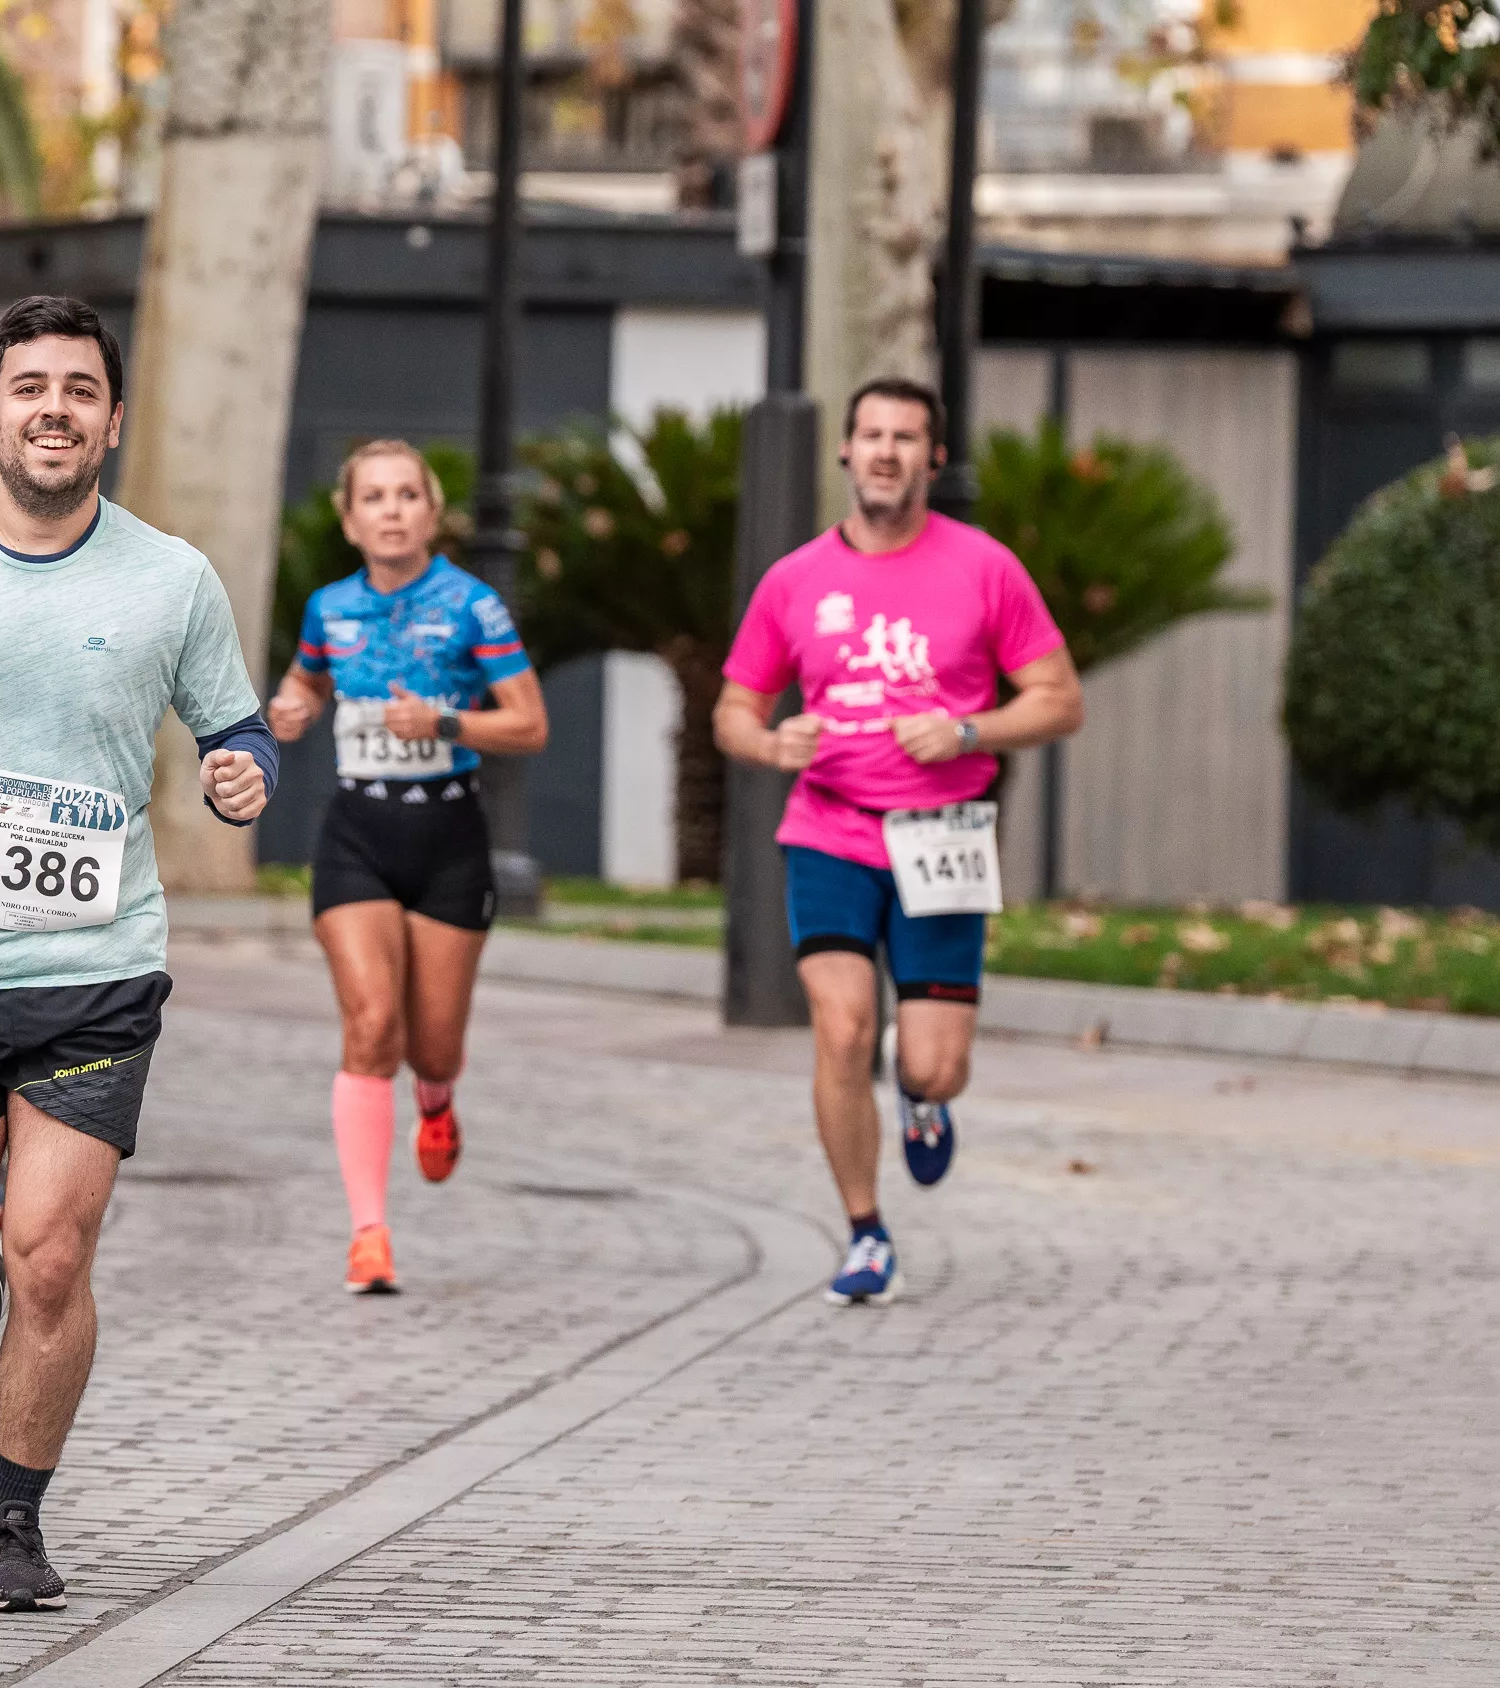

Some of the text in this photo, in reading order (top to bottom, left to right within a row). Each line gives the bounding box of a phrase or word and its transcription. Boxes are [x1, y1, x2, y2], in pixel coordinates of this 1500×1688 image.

[0, 777, 41, 792] PROVINCIAL
[43, 784, 52, 793] DE
[6, 786, 52, 801] POPULARES
[52, 785, 97, 808] 2024
[10, 833, 68, 848] POR LA IGUALDAD
[12, 824, 25, 832] C.P.
[26, 826, 51, 836] CIUDAD
[51, 830, 60, 838] DE
[60, 831, 85, 841] LUCENA
[914, 849, 987, 884] 1410
[22, 905, 45, 914] OLIVA
[53, 1057, 112, 1080] JOHN SMITH
[6, 1509, 27, 1521] NIKE
